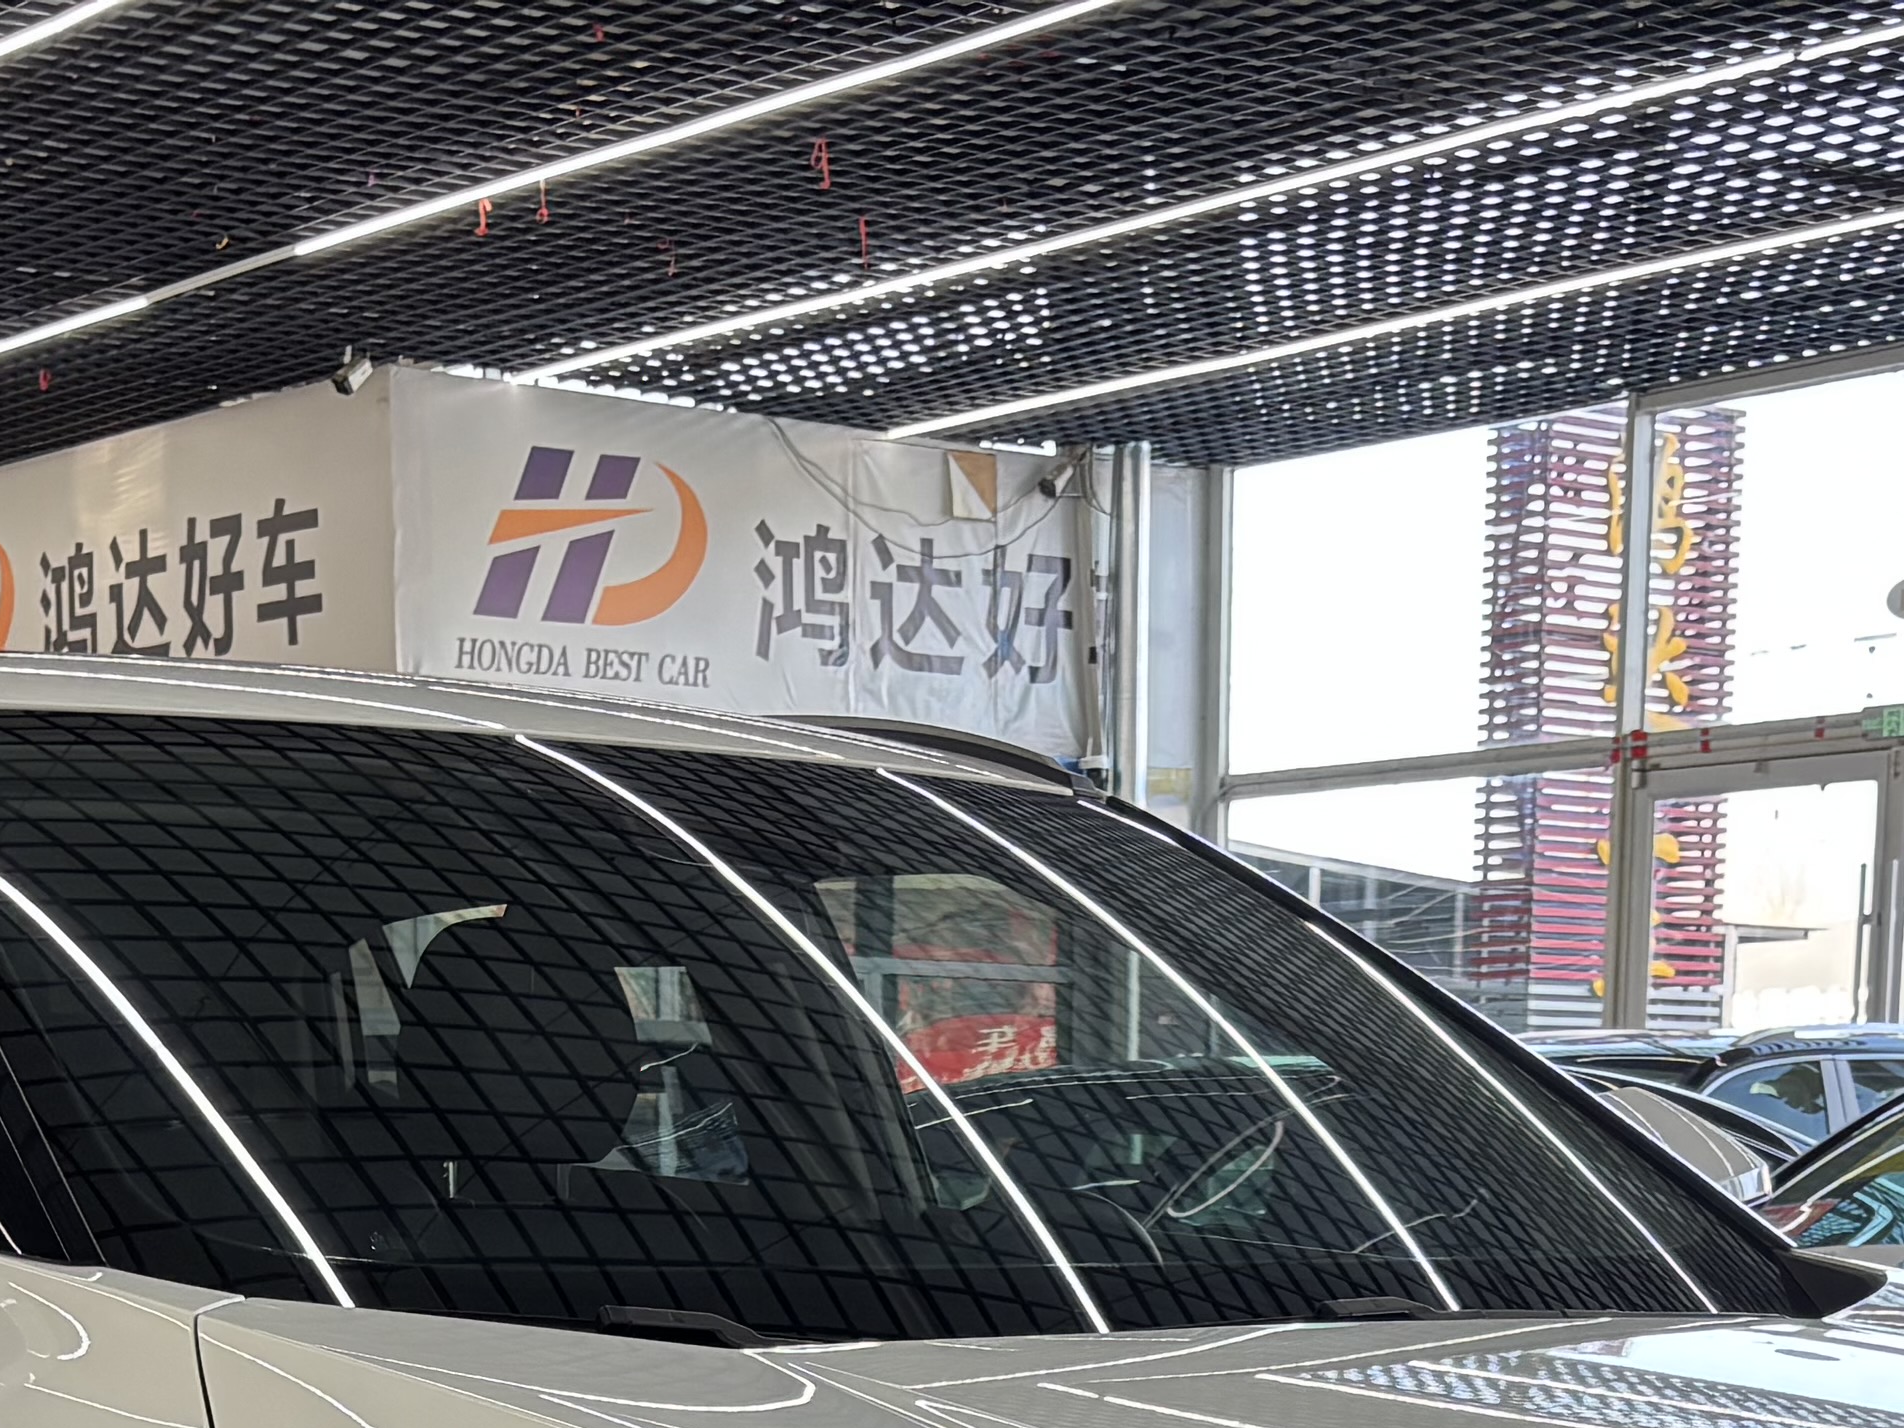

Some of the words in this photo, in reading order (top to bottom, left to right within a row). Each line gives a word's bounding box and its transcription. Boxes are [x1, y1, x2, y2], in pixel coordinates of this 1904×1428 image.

[40, 498, 323, 656] 鸿达好车
[754, 519, 1100, 684] 鸿达好
[455, 638, 571, 678] HONGDA
[584, 647, 649, 683] BEST
[658, 653, 710, 688] CAR
